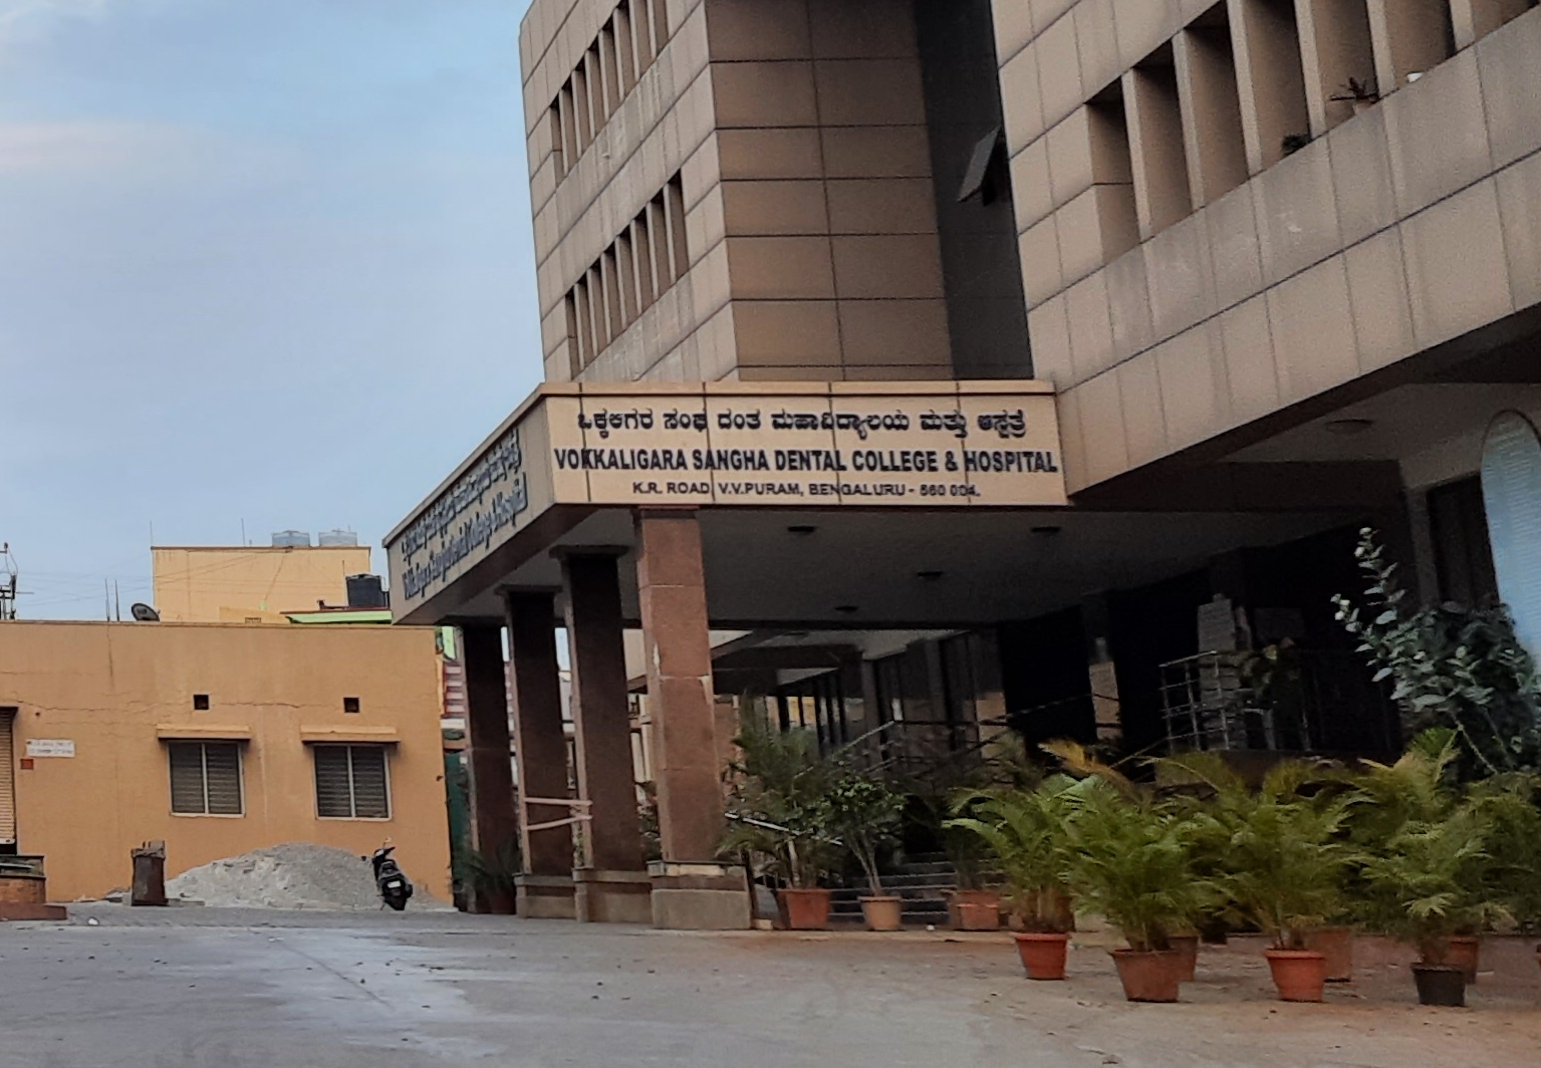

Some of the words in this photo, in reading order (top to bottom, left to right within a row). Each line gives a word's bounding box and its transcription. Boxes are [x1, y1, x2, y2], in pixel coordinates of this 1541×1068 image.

[578, 408, 654, 439] ಒಕ್ಕಲಿಗರ
[663, 408, 708, 432] ಸಂಘ
[717, 408, 761, 429] ದಂತ
[771, 408, 909, 440] ಮಹಾವಿದ್ಯಾಲಯ
[920, 409, 967, 439] ಮತ್ತು
[554, 448, 688, 470] VOKKALIGARA
[693, 449, 770, 471] SANGHA
[774, 449, 847, 471] DENTAL
[852, 450, 938, 472] COLLEGE
[945, 450, 958, 472] &
[964, 450, 1058, 473] HOSPITAL
[633, 482, 663, 494] K.R.
[718, 482, 804, 496] V.V.PURAM,
[809, 483, 906, 496] BENGALURU
[920, 484, 946, 496] 560
